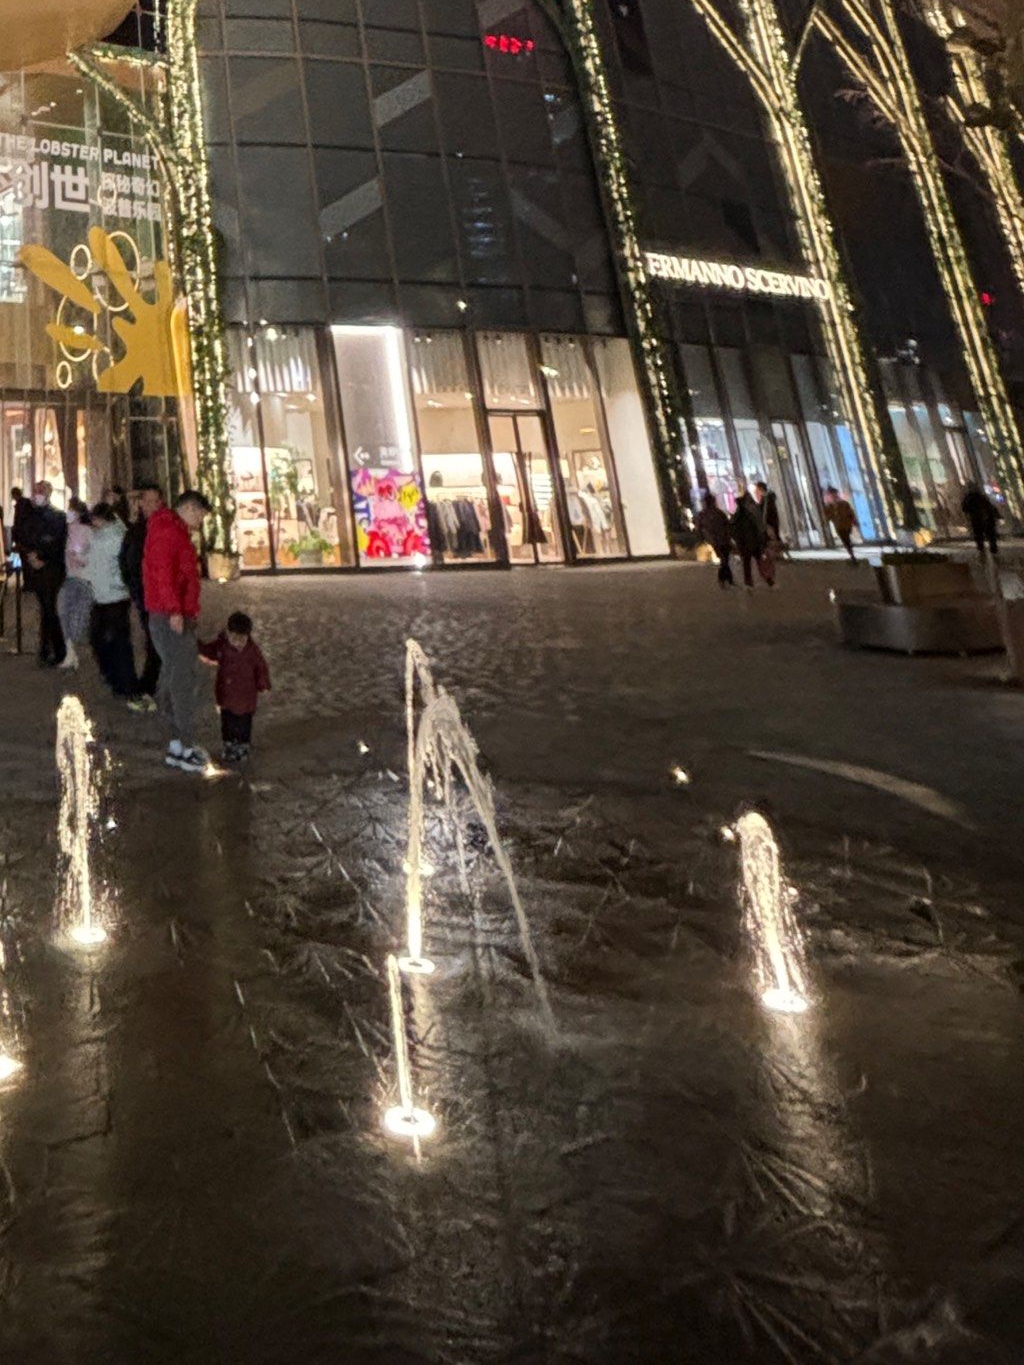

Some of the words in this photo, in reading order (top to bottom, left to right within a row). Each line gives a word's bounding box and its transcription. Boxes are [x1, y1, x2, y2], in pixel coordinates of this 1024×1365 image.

[27, 135, 99, 161] LOBSTER
[103, 148, 159, 171] PLANET
[645, 252, 745, 290] ERMANNO
[745, 267, 831, 300] SCERVINO
